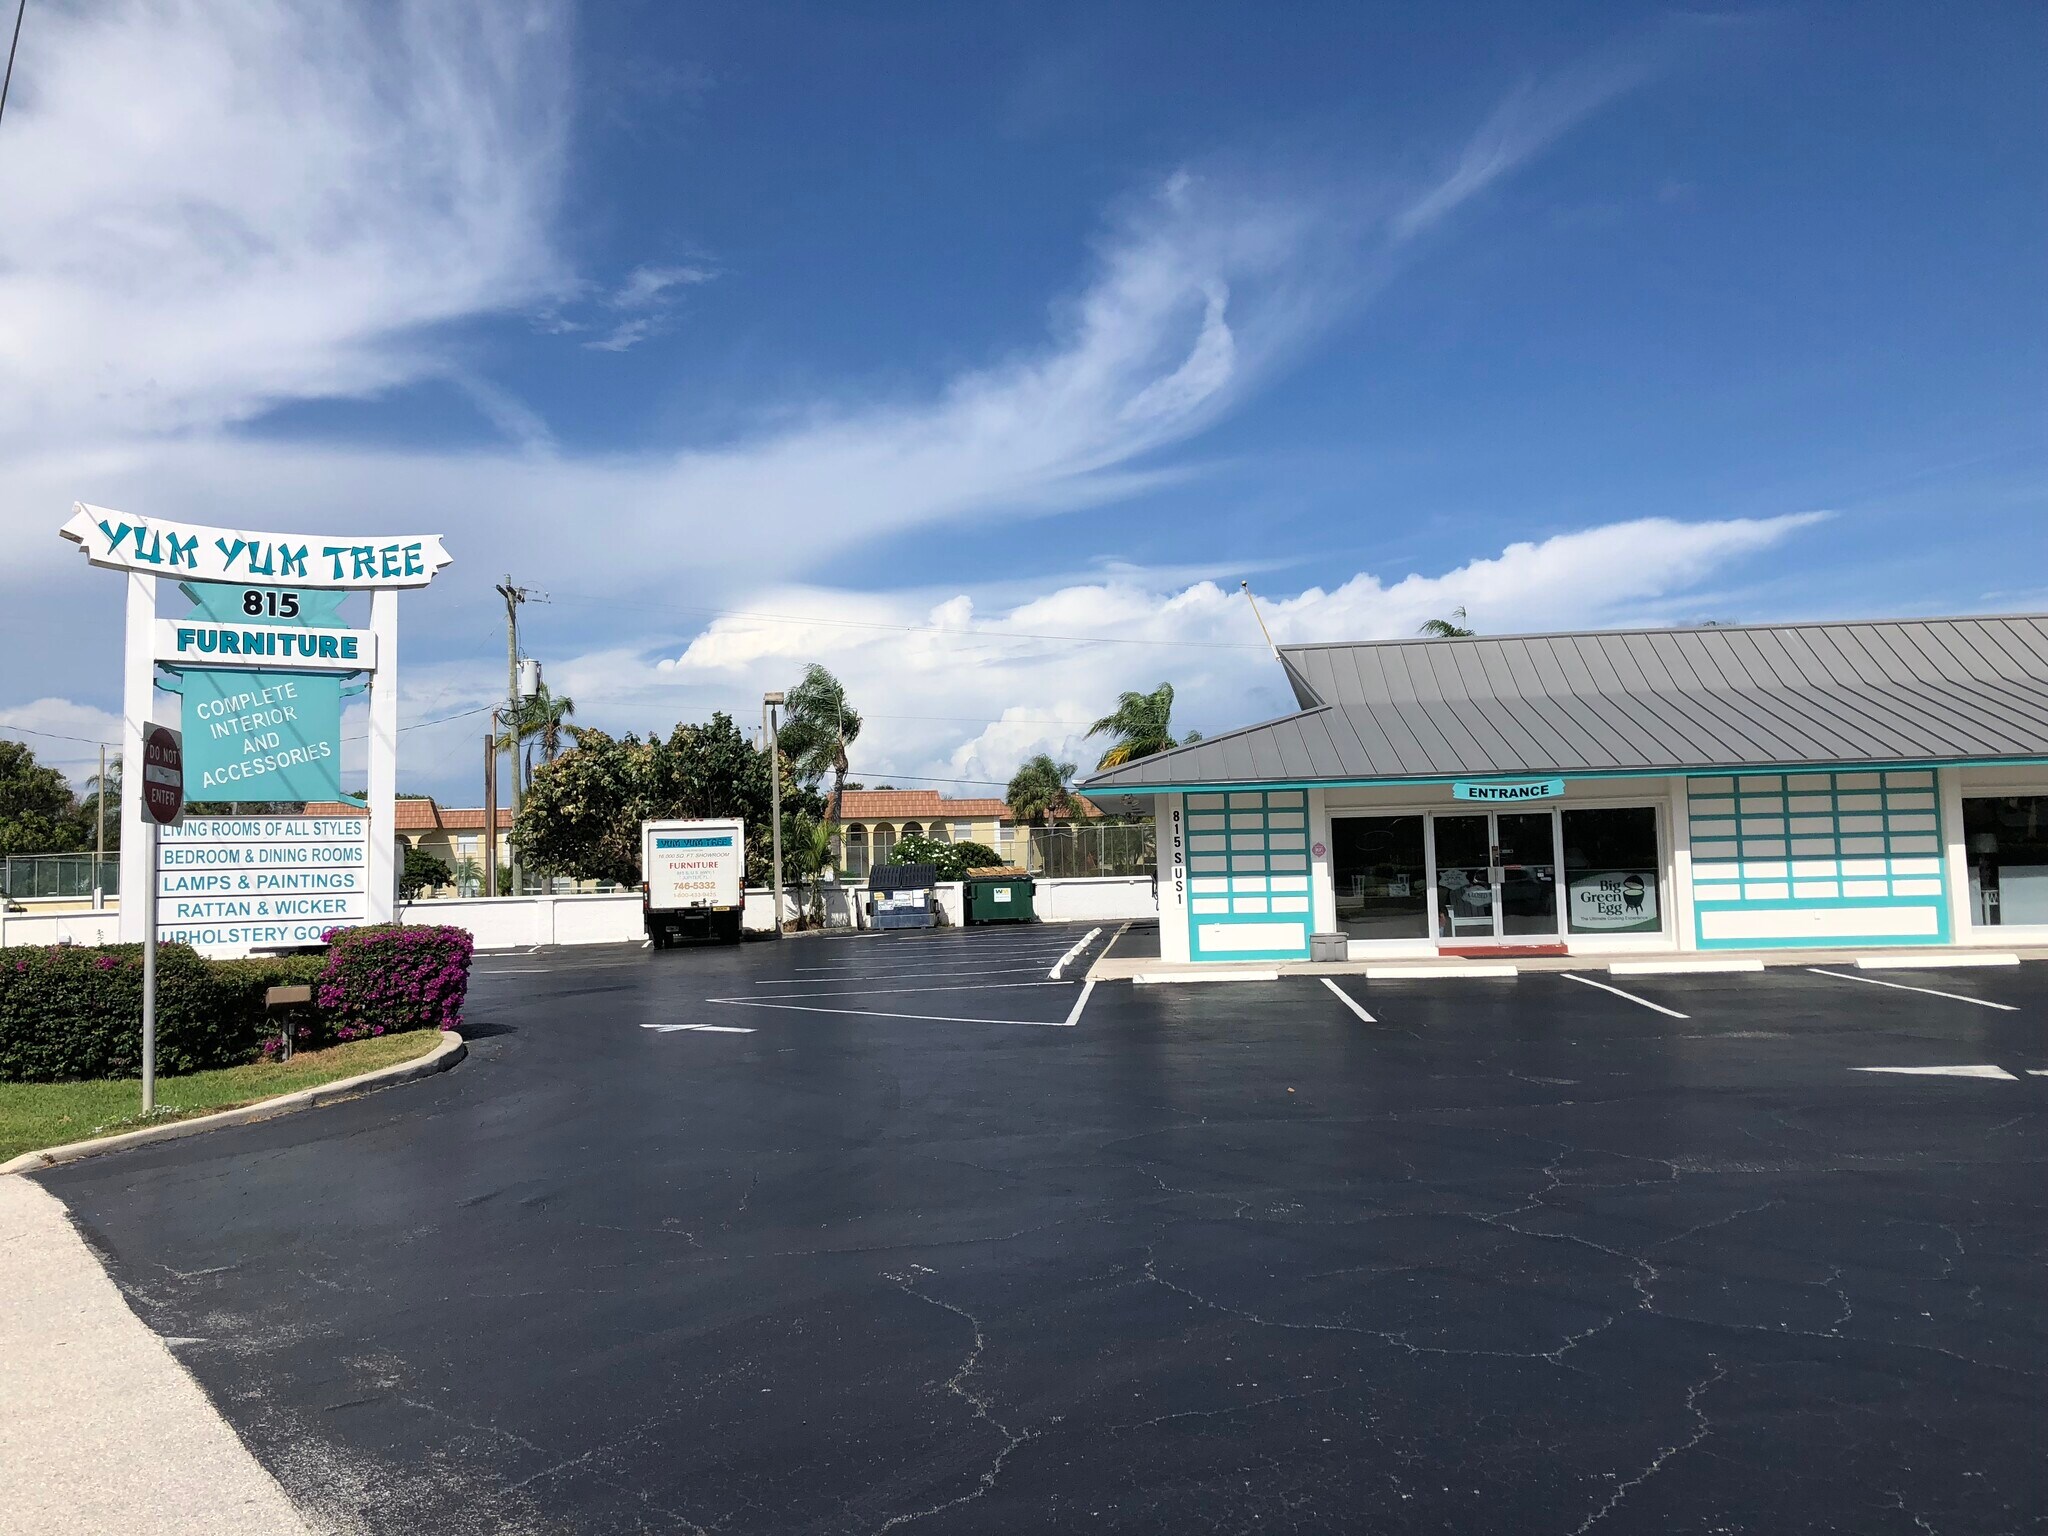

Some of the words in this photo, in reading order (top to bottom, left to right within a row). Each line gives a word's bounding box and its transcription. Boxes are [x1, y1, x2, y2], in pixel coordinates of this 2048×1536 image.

[99, 520, 199, 569] YUM
[215, 537, 309, 578] YUM
[323, 543, 424, 580] TREE
[243, 590, 299, 619] 815
[177, 628, 358, 660] FURNITURE
[197, 682, 298, 720] COMPLETE
[210, 706, 298, 740] INTERIOR
[243, 732, 280, 755] AND
[149, 744, 160, 760] DO
[163, 748, 177, 765] NOT
[203, 741, 331, 789] ACCESSORIES
[151, 788, 175, 806] ENTER
[1469, 785, 1549, 798] ENTRANCE
[163, 822, 207, 836] LIVING
[211, 822, 261, 836] ROOMS
[265, 822, 282, 836] OF
[285, 822, 309, 836] ALL
[313, 821, 362, 835] STYLES
[661, 840, 680, 848] YUM
[684, 839, 703, 847] YUM
[706, 838, 728, 847] TREE
[164, 849, 240, 865] BEDROOM
[245, 849, 254, 863] &
[259, 848, 307, 863] DINING
[312, 847, 362, 862] ROOMS
[669, 861, 719, 870] FURNITURE
[164, 875, 231, 892] LAMPS
[238, 875, 250, 890] &
[257, 874, 355, 889] PAINTINGS
[673, 881, 716, 890] 746-5332
[1600, 880, 1621, 893] Big
[1580, 891, 1622, 903] Green
[178, 901, 250, 918] RATTAN
[257, 901, 269, 916] &
[275, 899, 347, 915] WICKER
[1598, 902, 1623, 916] Egg
